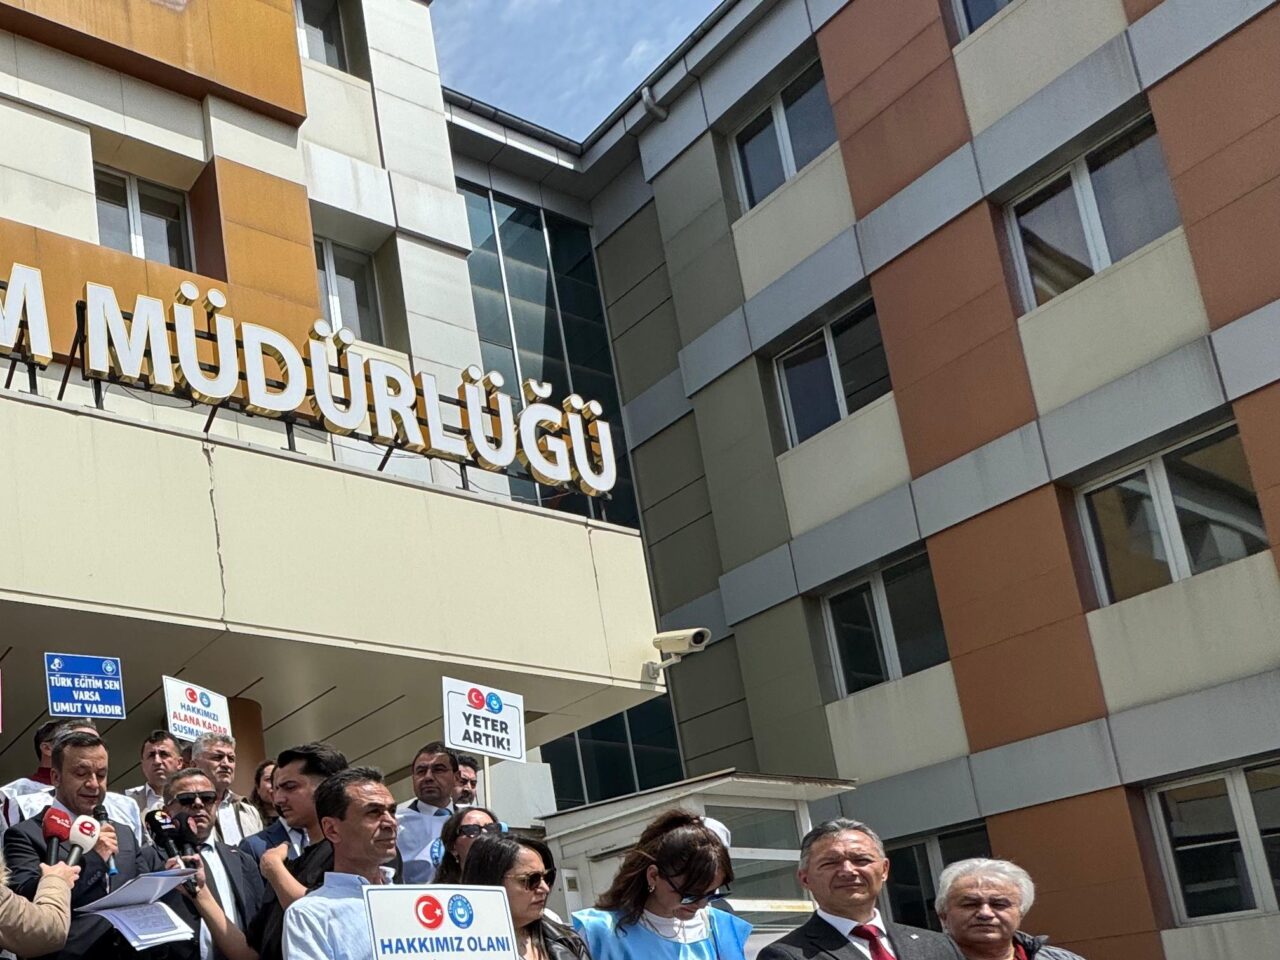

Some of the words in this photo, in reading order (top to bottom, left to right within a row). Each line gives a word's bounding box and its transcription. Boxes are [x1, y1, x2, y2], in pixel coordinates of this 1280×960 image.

[85, 280, 617, 494] MÜDÜRLÜĞÜ
[49, 675, 72, 688] TÜRK
[74, 675, 103, 689] EĞİTİM
[104, 679, 120, 690] SEN
[72, 690, 101, 702] VARSA
[53, 701, 82, 713] UMUT
[86, 703, 122, 715] VARDIR
[180, 702, 219, 721] HAKKIMIZI
[172, 711, 201, 727] ALANA
[202, 719, 227, 735] KADAR
[462, 711, 509, 735] YETER
[462, 729, 511, 751] ARTIK!
[380, 936, 465, 954] HAKKIMIZ
[467, 936, 511, 952] OLANI
